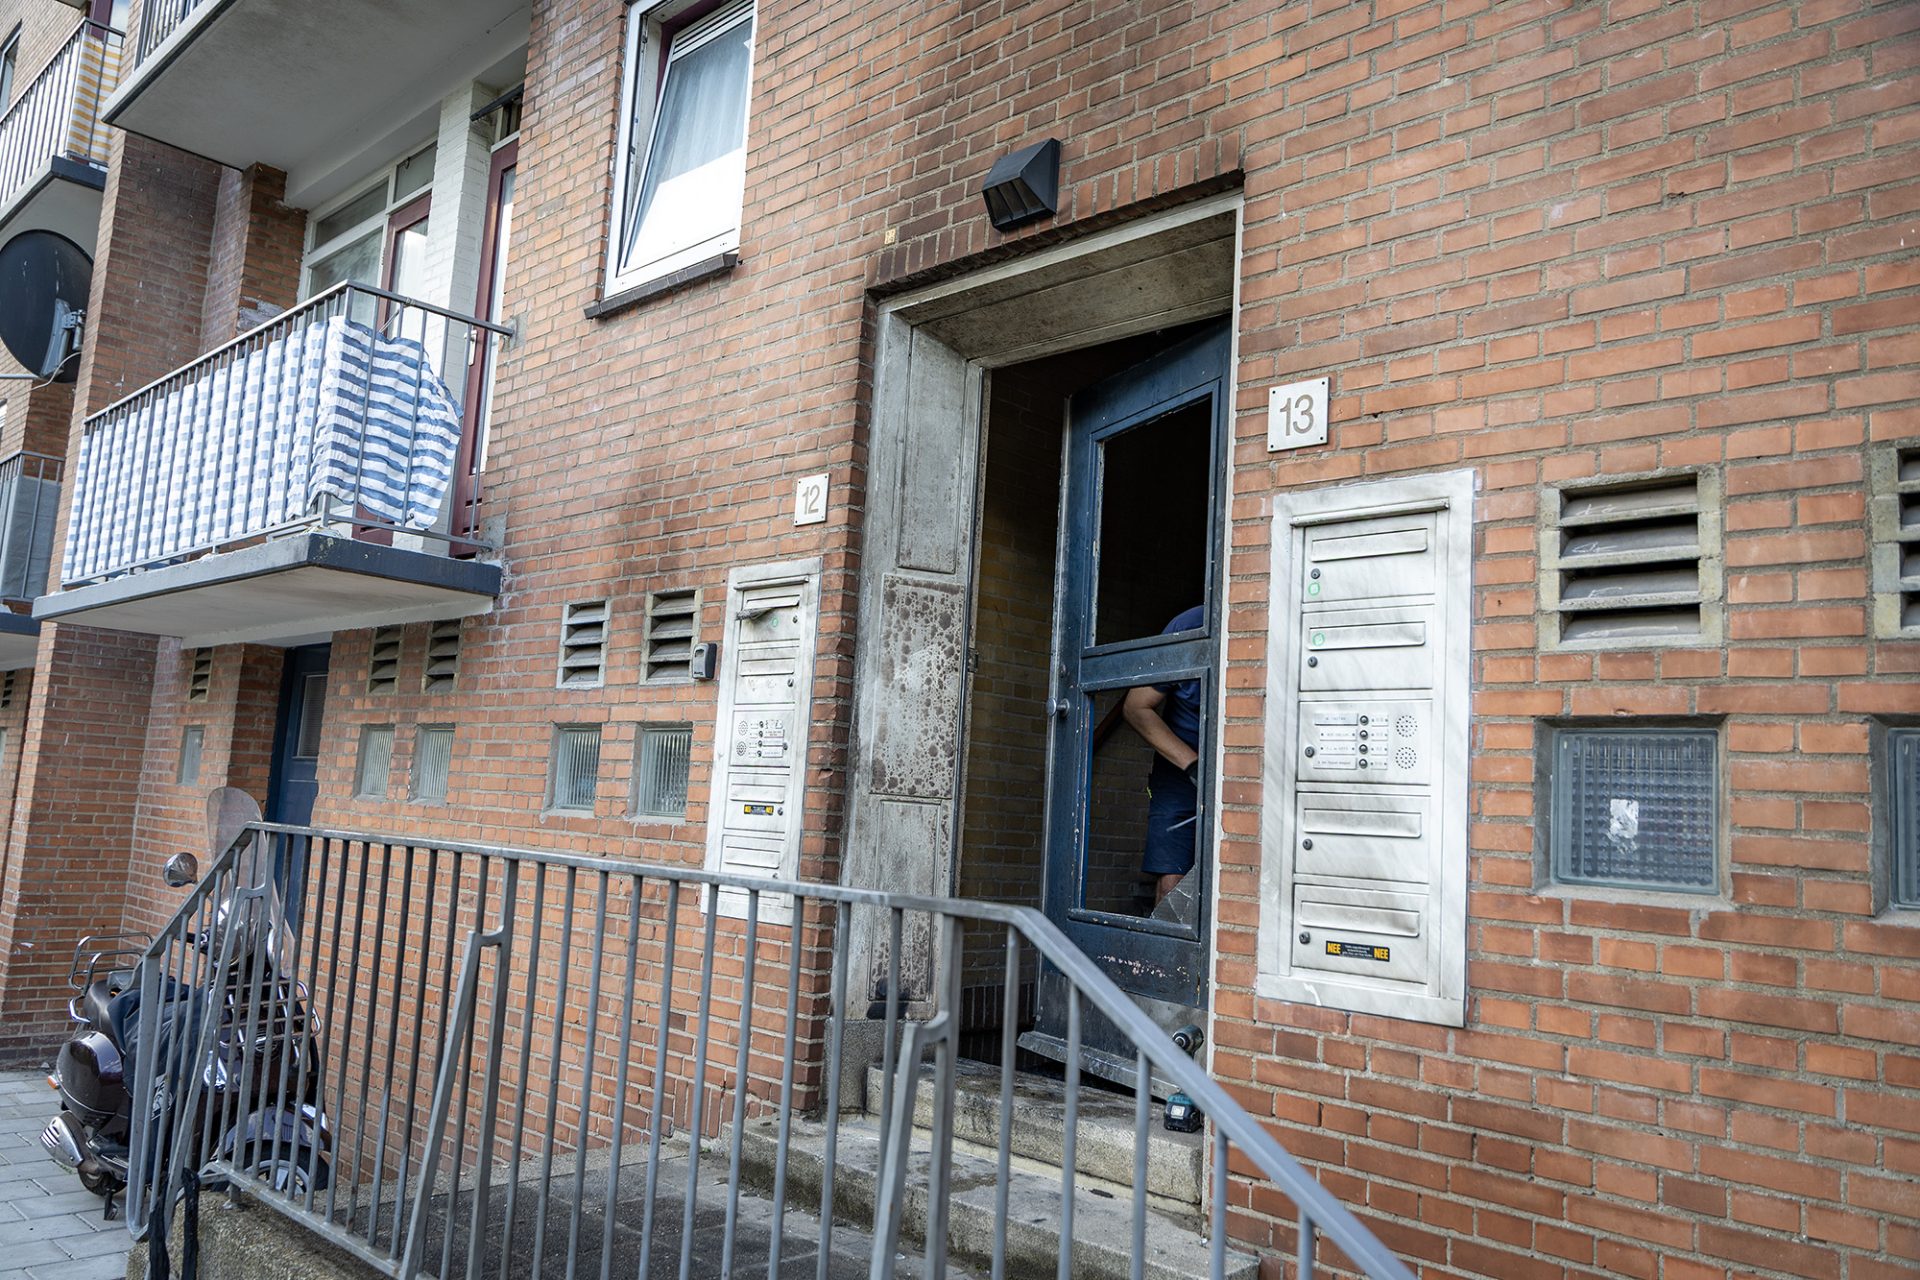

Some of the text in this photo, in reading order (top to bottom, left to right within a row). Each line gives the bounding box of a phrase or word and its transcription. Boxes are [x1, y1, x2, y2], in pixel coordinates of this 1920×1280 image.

[1280, 394, 1315, 436] 13
[802, 484, 821, 515] 12
[1327, 942, 1341, 954] NEE
[1374, 947, 1389, 960] NEE
